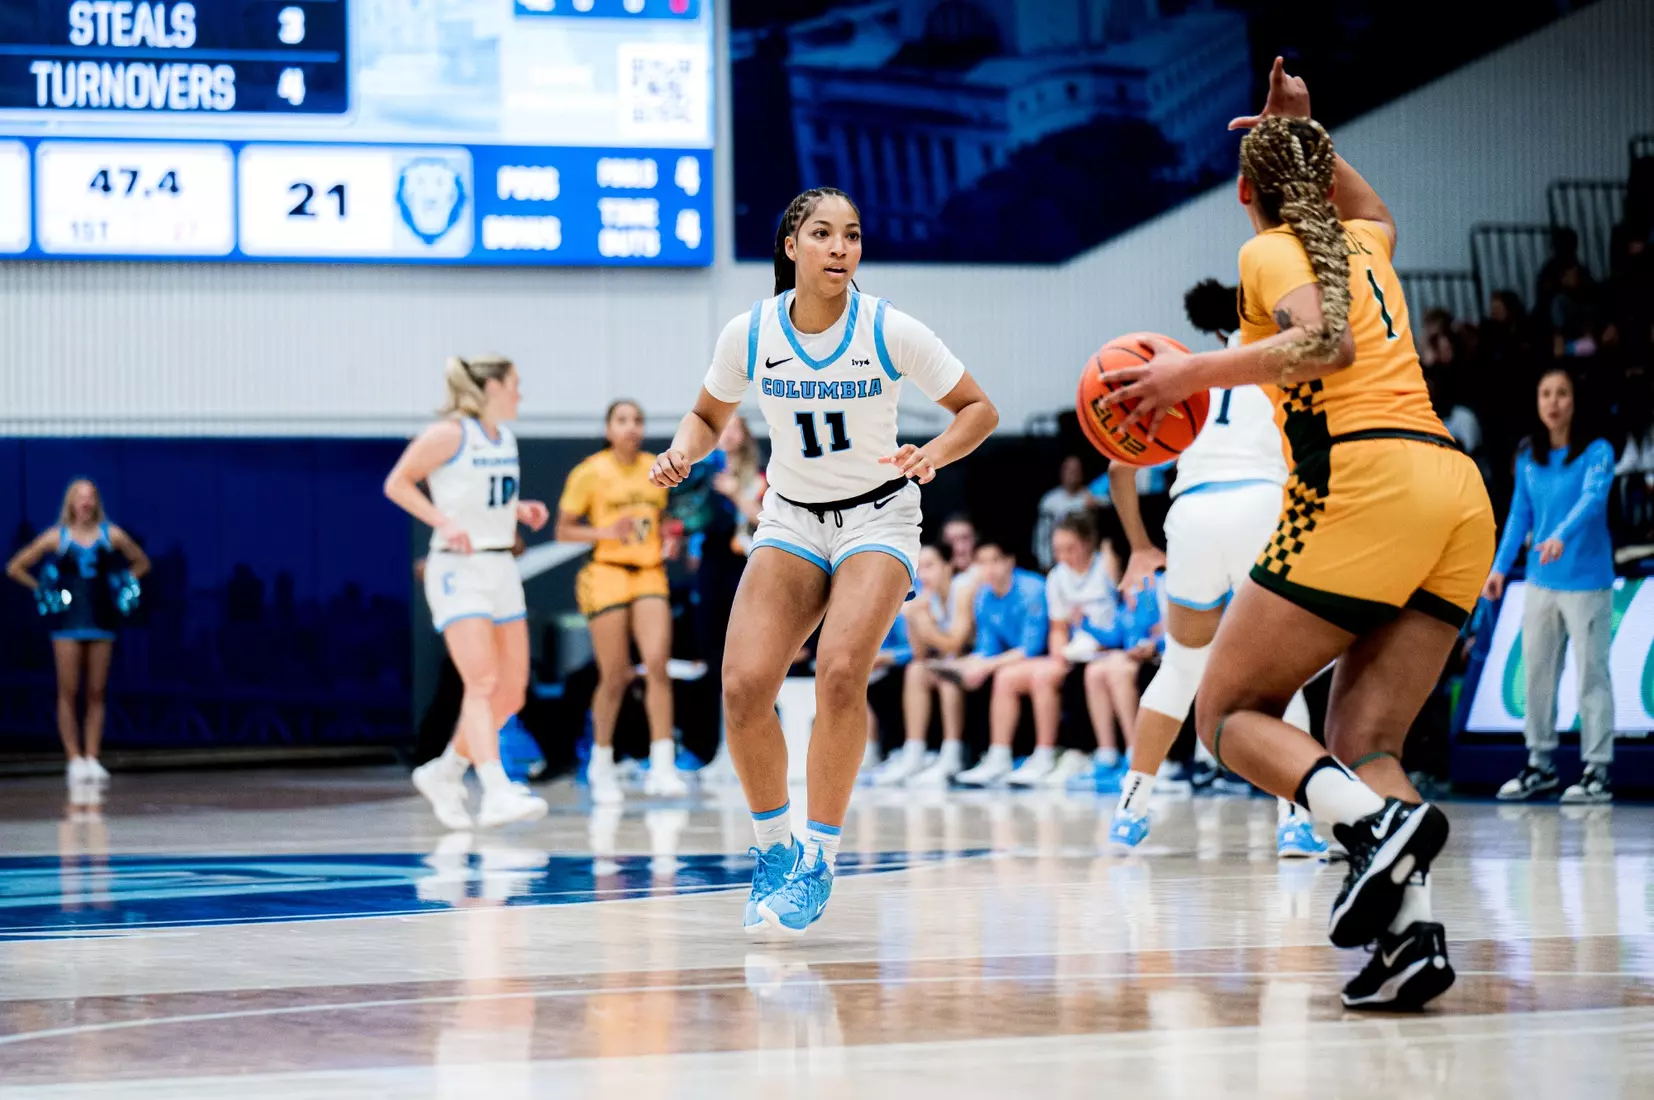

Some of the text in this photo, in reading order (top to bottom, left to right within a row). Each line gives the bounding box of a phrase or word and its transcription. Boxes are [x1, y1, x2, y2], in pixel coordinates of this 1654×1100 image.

[69, 0, 196, 48] STEALS
[29, 60, 306, 111] TURNOVERS 4
[89, 168, 181, 197] 47.4
[287, 182, 348, 217] 21
[761, 377, 882, 399] COLUMBIA
[793, 410, 852, 459] 11
